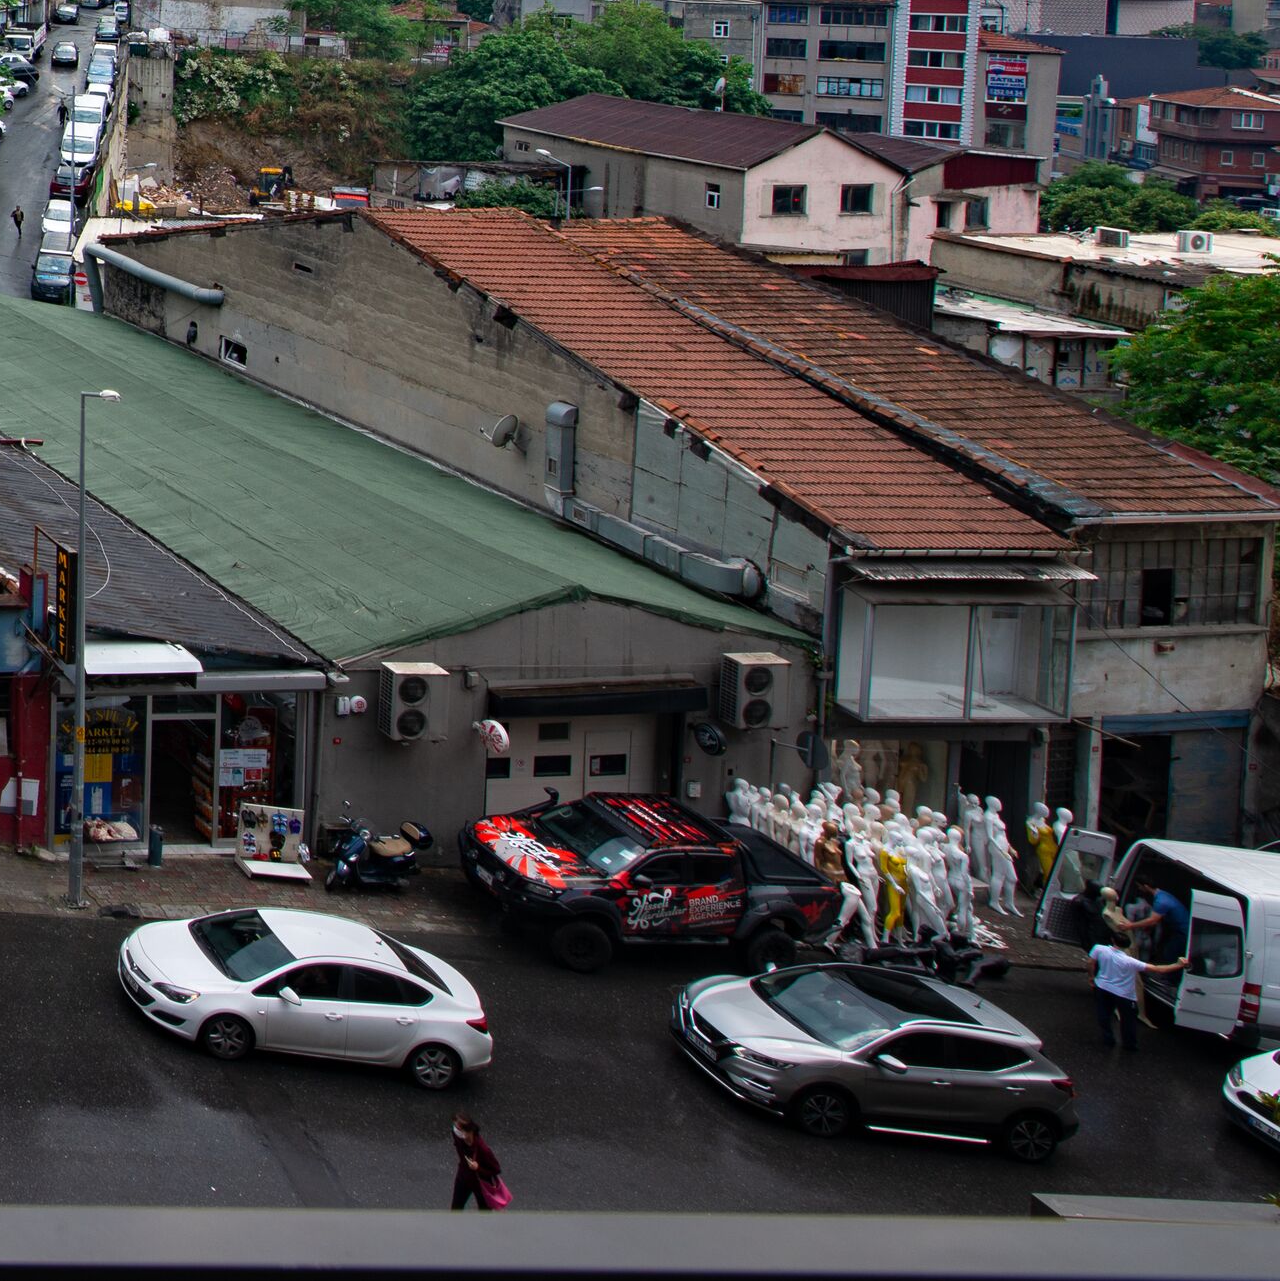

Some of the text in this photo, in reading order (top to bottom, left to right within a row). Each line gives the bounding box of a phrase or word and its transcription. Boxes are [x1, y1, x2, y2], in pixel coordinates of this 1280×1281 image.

[58, 551, 68, 656] MARKET
[84, 727, 122, 737] ARKET
[688, 895, 719, 907] BRAND
[688, 899, 741, 914] EXPERIENCE
[688, 910, 725, 921] AGENCY
